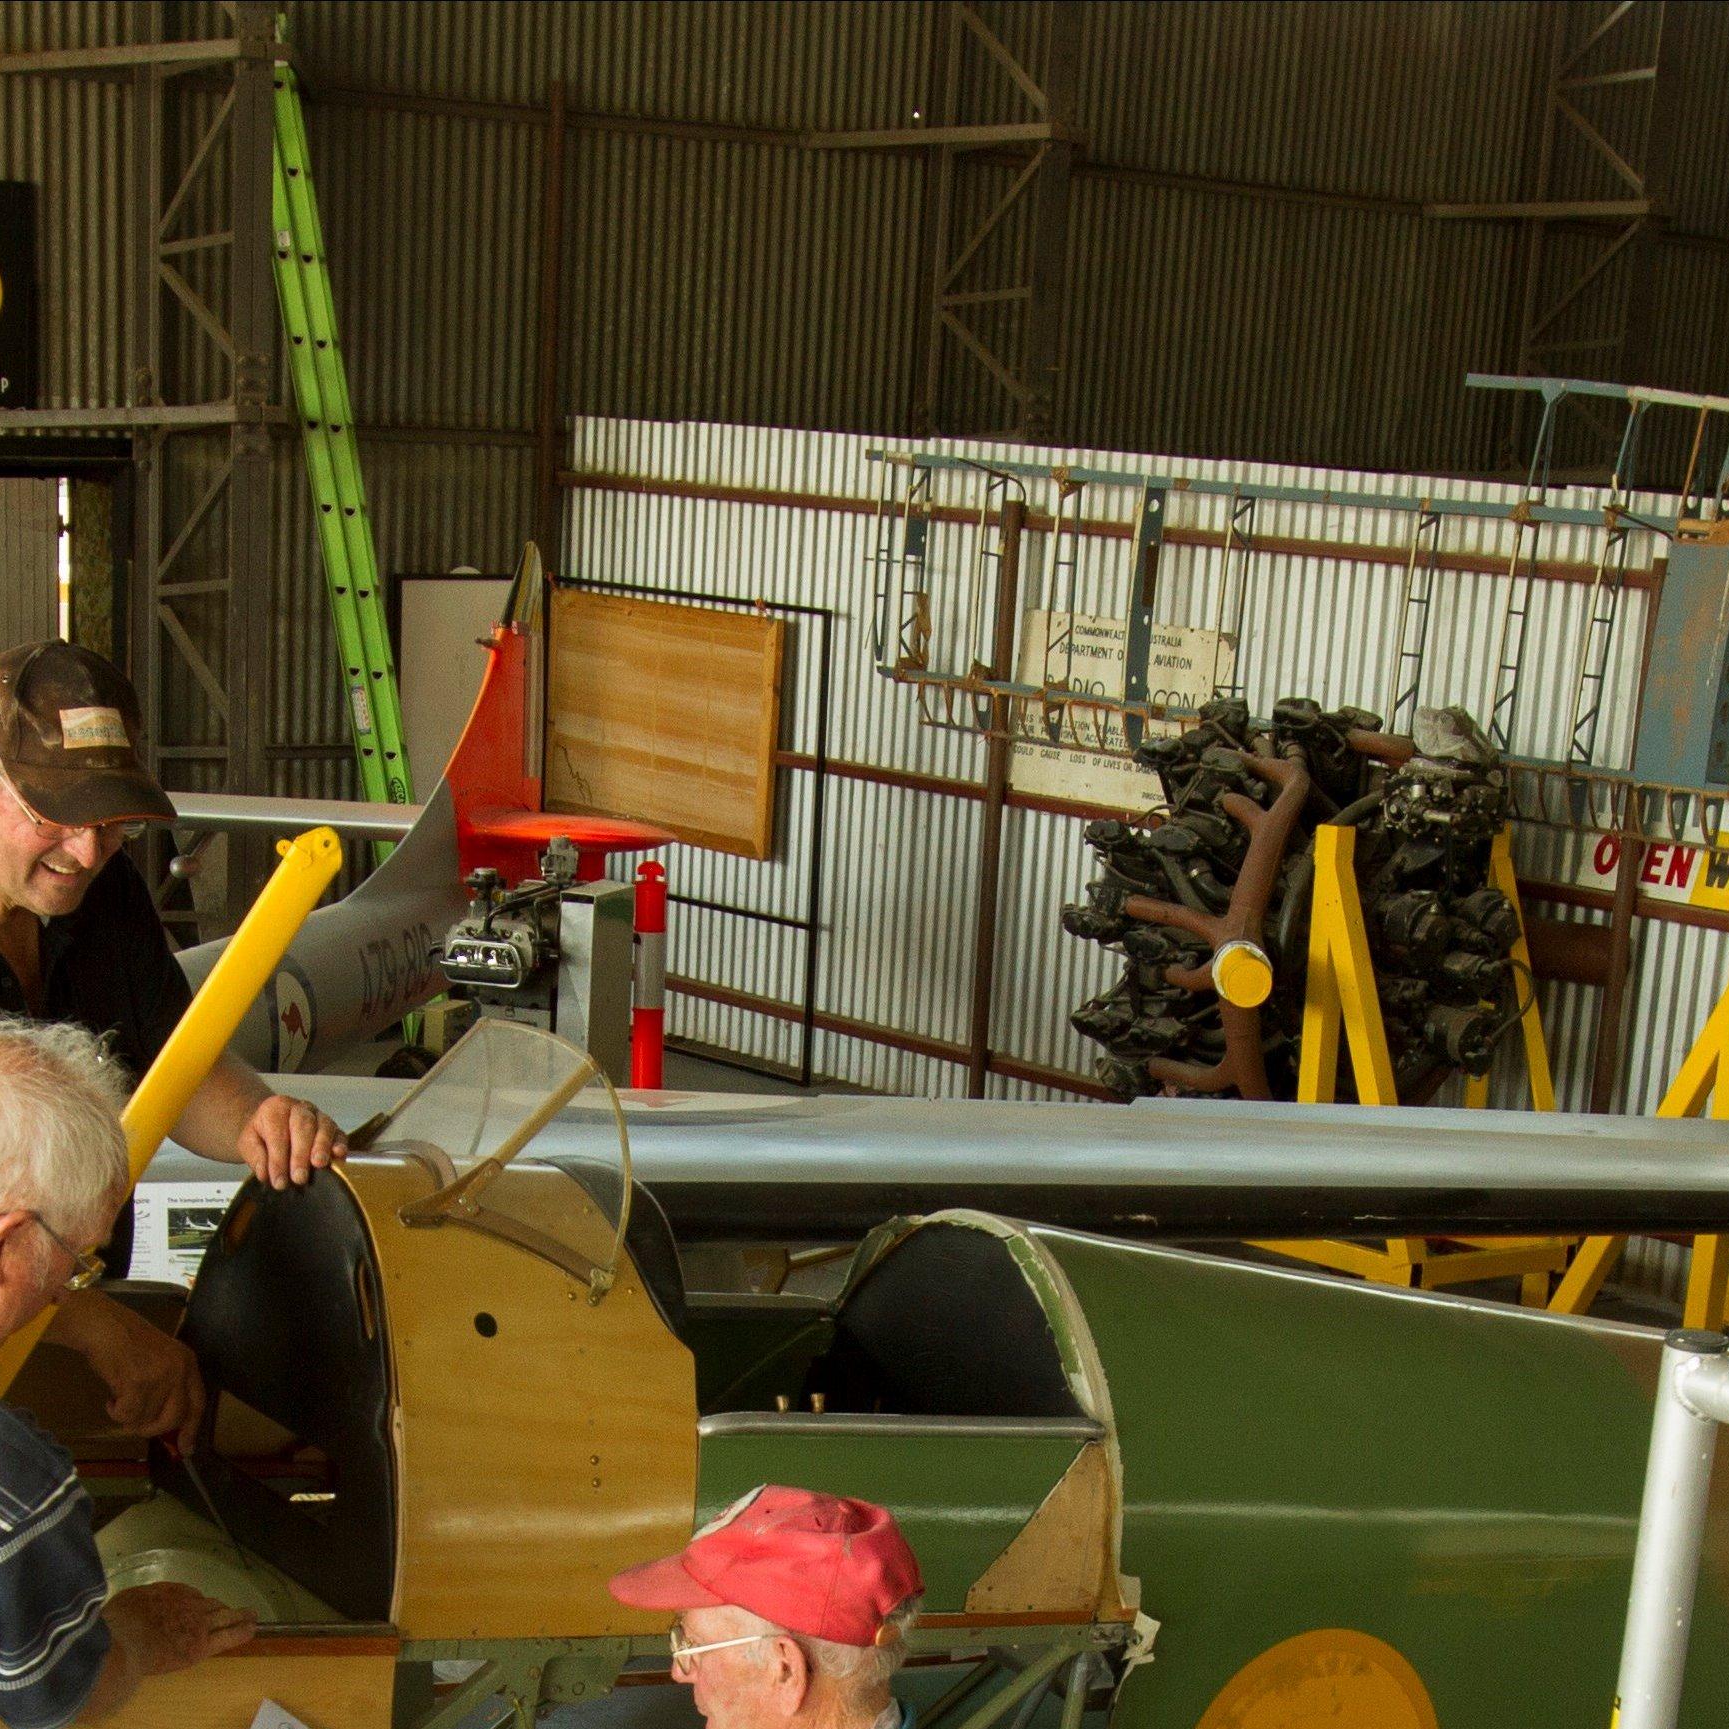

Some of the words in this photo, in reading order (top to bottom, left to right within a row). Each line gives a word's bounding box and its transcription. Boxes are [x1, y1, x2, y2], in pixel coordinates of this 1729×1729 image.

[1075, 625, 1125, 641] COMMONWEALT
[1150, 634, 1182, 649] USTRALIA
[1059, 643, 1114, 661] DEPARTMENT
[1153, 655, 1193, 671] AVIATION
[1040, 748, 1061, 762] CAUSE
[1070, 754, 1086, 765] LOSS
[1093, 757, 1101, 767] OF
[1103, 759, 1120, 771] LIVES
[1594, 834, 1696, 889] OEN
